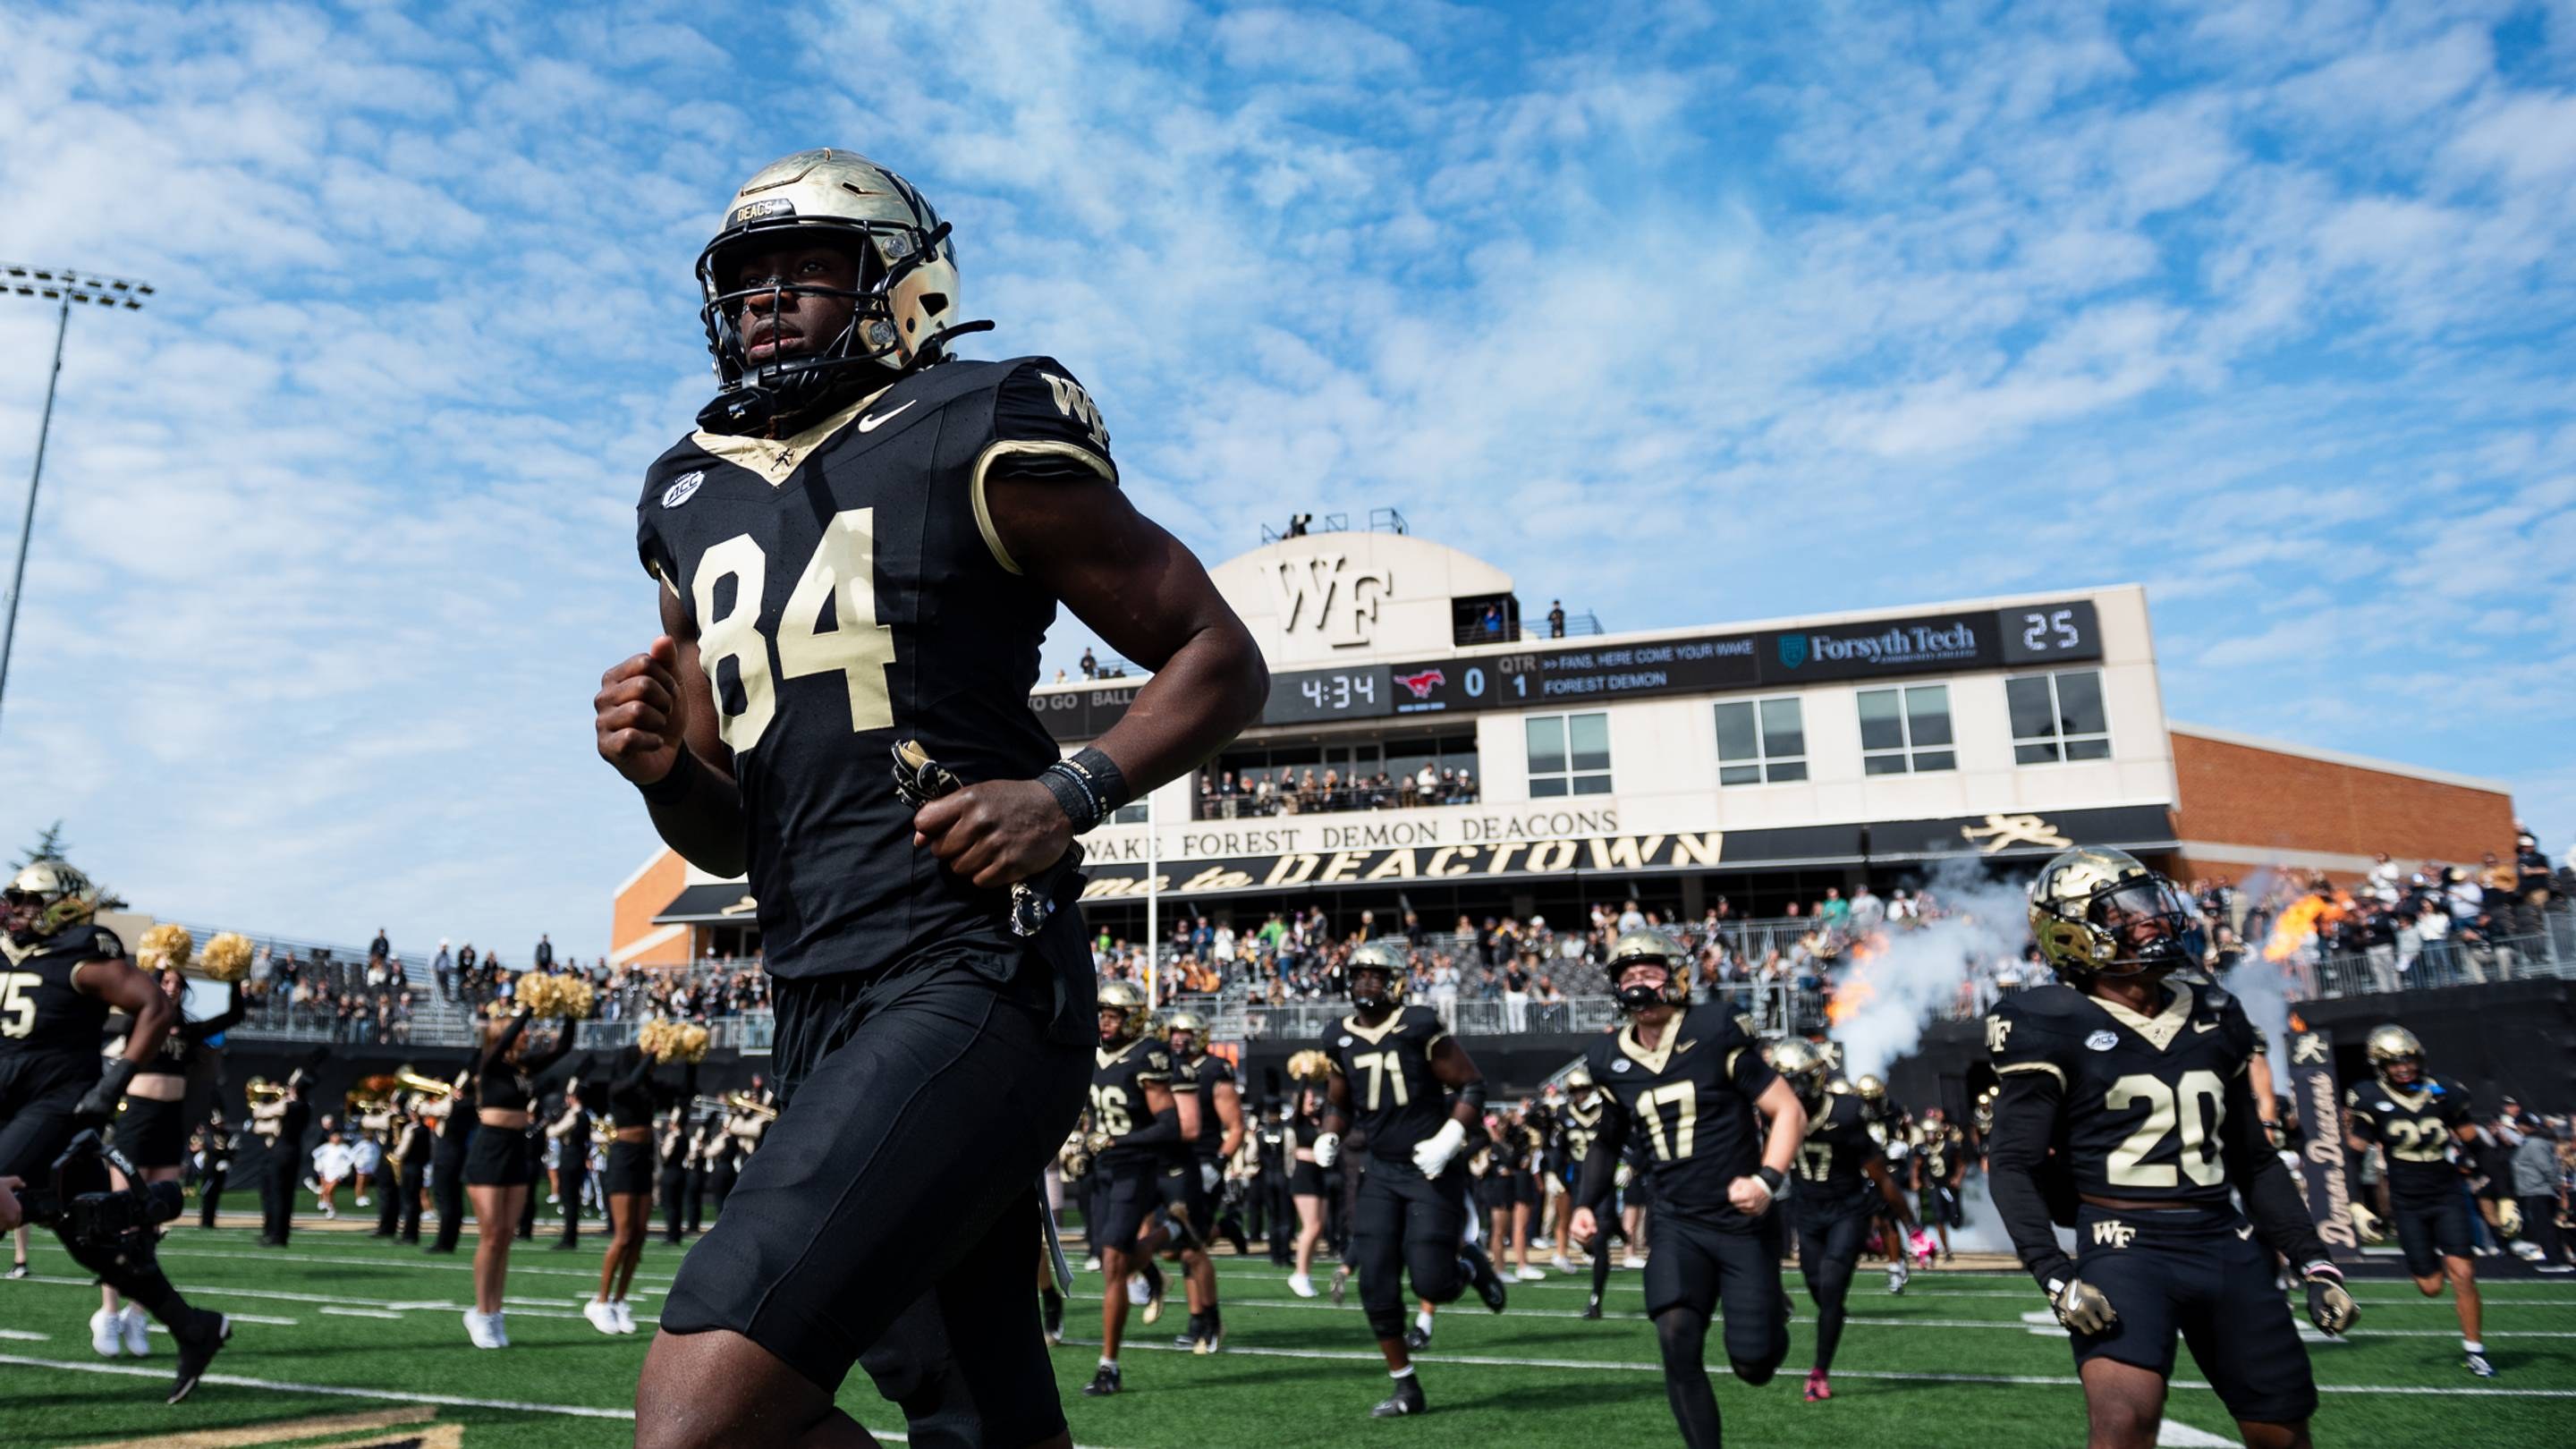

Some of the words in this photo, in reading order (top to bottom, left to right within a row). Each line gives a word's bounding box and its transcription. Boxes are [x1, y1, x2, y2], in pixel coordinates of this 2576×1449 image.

[737, 201, 774, 223] DEACS
[1258, 553, 1393, 650] WF
[691, 506, 897, 755] 84
[1811, 628, 1911, 664] Forsyth
[1909, 622, 1975, 651] Tech
[2023, 609, 2080, 651] 25
[1498, 655, 1537, 673] QTR
[1597, 649, 1632, 667] HERE
[1634, 645, 1674, 664] COME
[1676, 643, 1715, 660] YOUR
[1716, 639, 1753, 657] WAKE
[1050, 693, 1078, 711] GO
[1092, 689, 1132, 708] BALL
[1301, 674, 1375, 708] 4:34
[1464, 667, 1485, 698] 0
[1513, 674, 1526, 698] 1
[1544, 675, 1604, 695] FOREST
[1607, 671, 1667, 691] DEMON
[1182, 829, 1301, 857] FOREST
[1323, 820, 1439, 850] DEMON
[1462, 809, 1618, 842] DEACONS
[1181, 866, 1254, 893] to
[1264, 831, 1723, 886] DEACTOWN
[0, 972, 43, 1038] 5
[1986, 1014, 2012, 1052] WF
[1352, 1050, 1410, 1111] 71
[1636, 1080, 1698, 1161] 17
[2106, 1070, 2227, 1187] 20
[2305, 1071, 2345, 1167] Deacons
[2386, 1117, 2450, 1163] 22
[2317, 1167, 2357, 1249] Demon
[2091, 1219, 2137, 1249] WF
